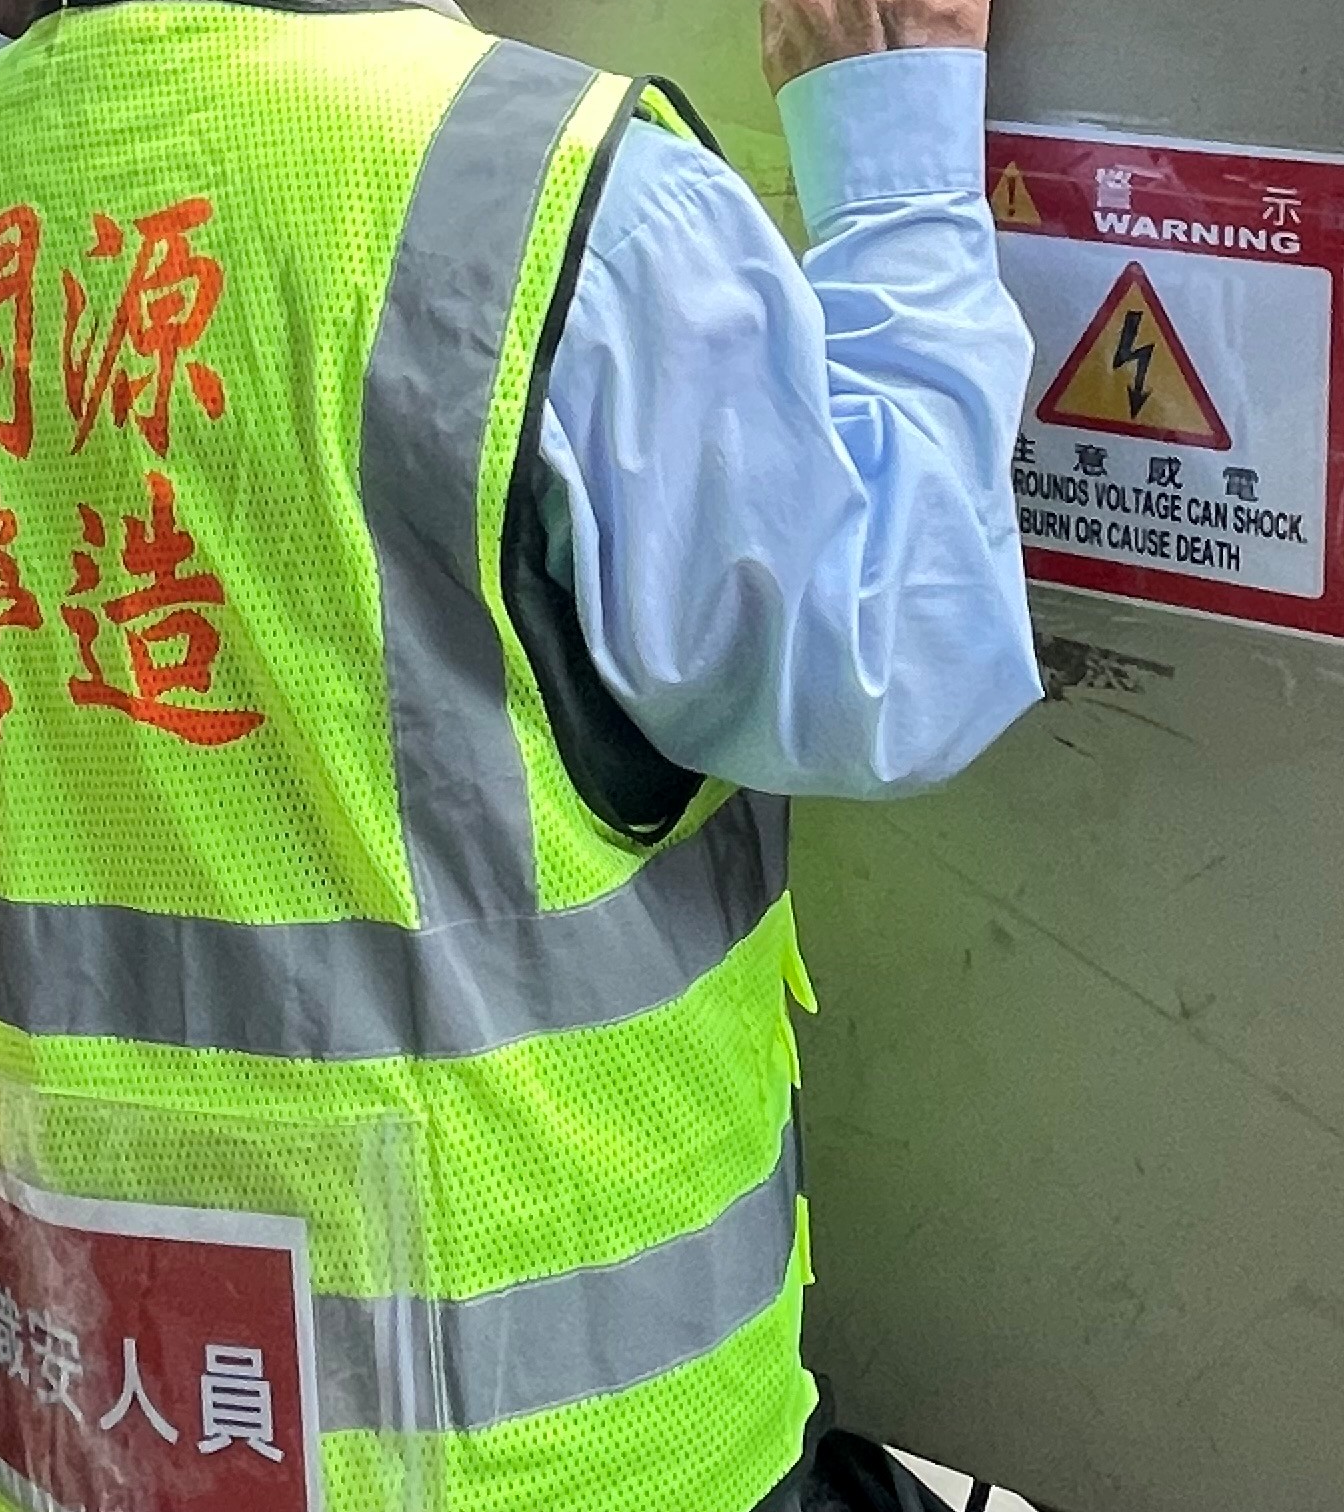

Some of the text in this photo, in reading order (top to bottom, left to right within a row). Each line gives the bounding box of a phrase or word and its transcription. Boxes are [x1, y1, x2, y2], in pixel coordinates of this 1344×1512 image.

[1092, 210, 1301, 255] WARNING
[1013, 468, 1090, 507] ROUNDS
[1094, 481, 1182, 524] VOLTAGE
[1187, 497, 1228, 532] CAN
[1020, 506, 1240, 572] BURN OR CAUSE DEATH
